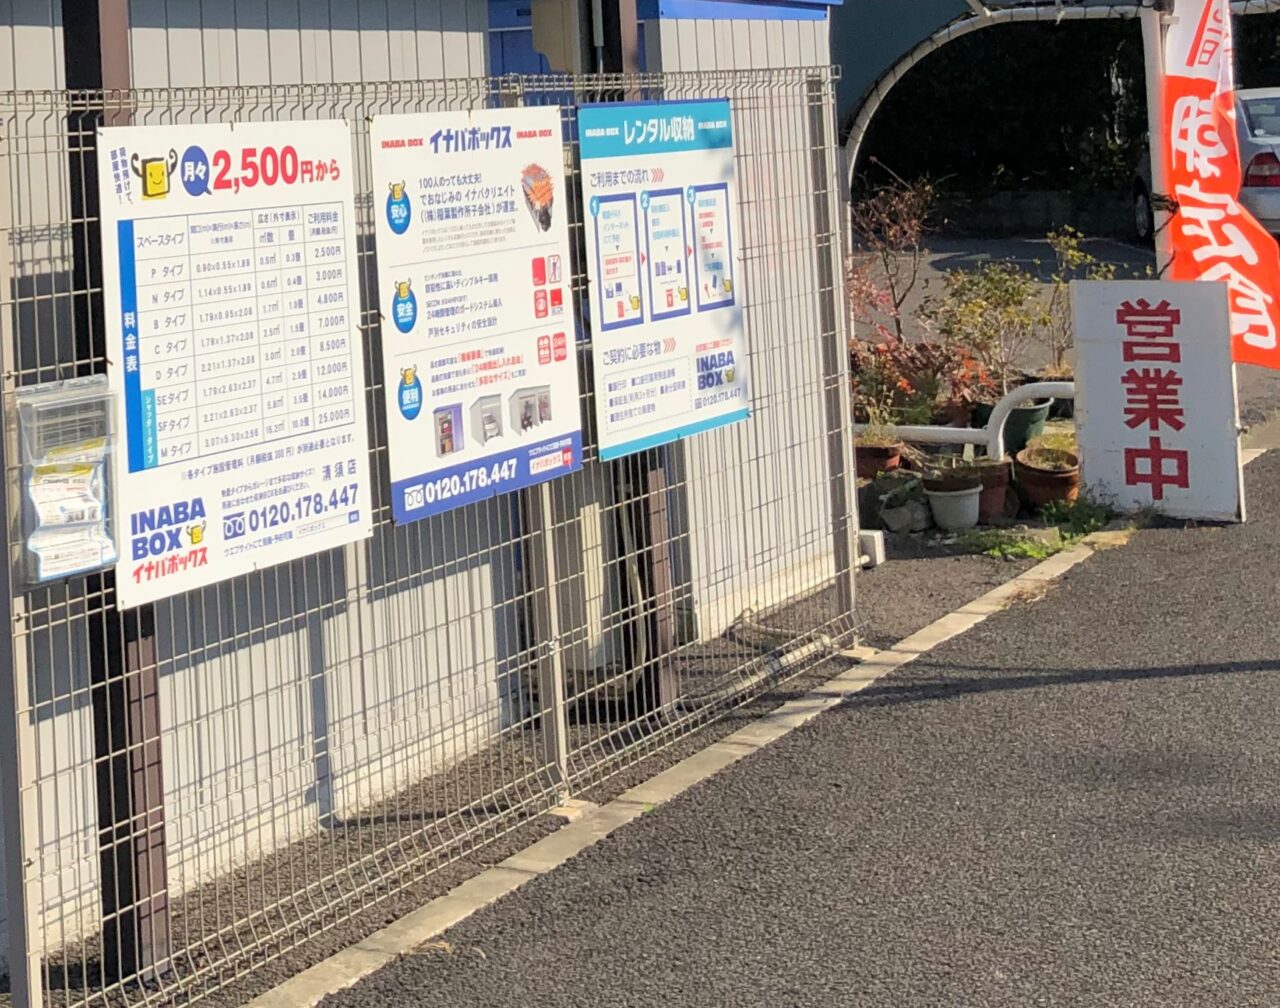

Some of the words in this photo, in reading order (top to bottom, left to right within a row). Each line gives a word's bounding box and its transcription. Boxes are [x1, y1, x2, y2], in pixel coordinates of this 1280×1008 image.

[429, 126, 512, 154] イナバボックス
[624, 115, 695, 145] レンタル収納
[381, 139, 406, 149] INABA
[407, 138, 424, 147] BOX
[183, 161, 209, 182] 月々
[212, 145, 341, 194] 2,500円から
[590, 168, 649, 188] ご利用までの流れ
[150, 268, 157, 278] P
[161, 264, 183, 277] タイプ
[151, 293, 158, 304] N
[162, 289, 184, 302] タイプ
[153, 319, 160, 329] B
[164, 314, 185, 328] タイプ
[396, 303, 413, 318] 安全
[124, 312, 138, 372] 料金表
[154, 344, 161, 355] C
[165, 339, 187, 353] タイプ
[155, 370, 162, 381] D
[166, 364, 188, 379] タイプ
[696, 351, 735, 373] INABA
[697, 370, 724, 390] BOX
[1116, 297, 1190, 501] 営業中
[160, 447, 167, 458] M
[170, 441, 192, 457] タイプ
[425, 458, 517, 503] 0120.178.447
[131, 497, 206, 535] INABA
[249, 483, 358, 532] 0120.178.447
[132, 525, 183, 561] BOX
[132, 547, 208, 584] イナバボックス
